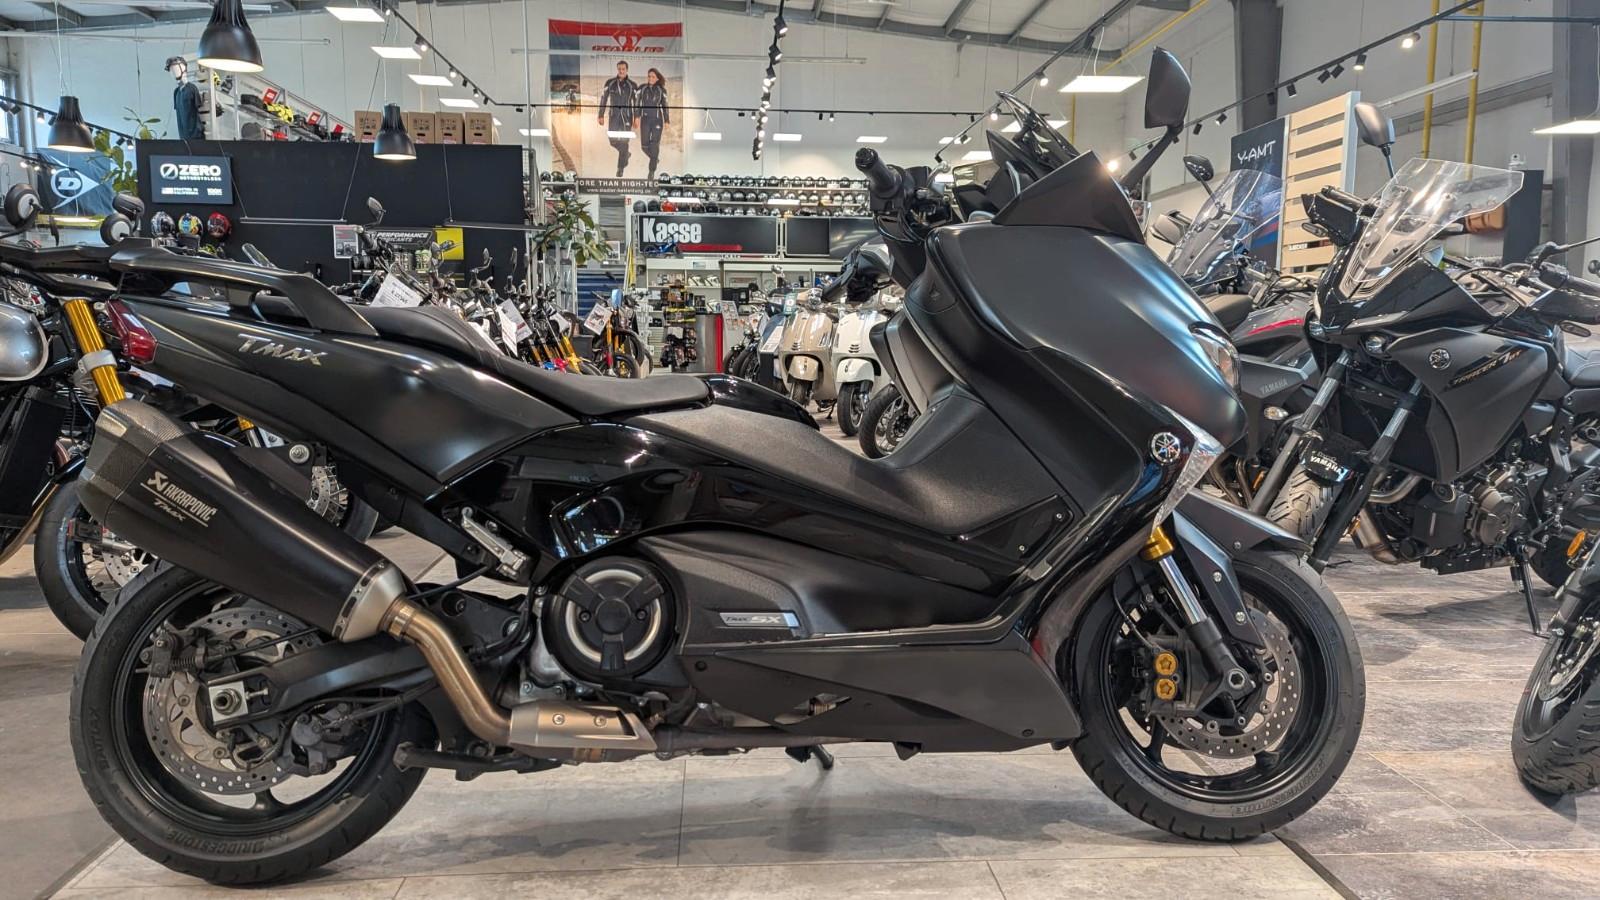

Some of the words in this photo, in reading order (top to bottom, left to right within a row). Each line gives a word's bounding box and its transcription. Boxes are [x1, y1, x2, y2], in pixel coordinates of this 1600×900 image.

[1237, 140, 1276, 164] Y-AMT
[178, 165, 222, 176] ZERO
[376, 231, 429, 239] PERFORMANCE
[642, 217, 702, 244] Kasse
[238, 333, 329, 366] TMAX
[1259, 377, 1289, 395] YAMAHA
[750, 615, 781, 624] SX
